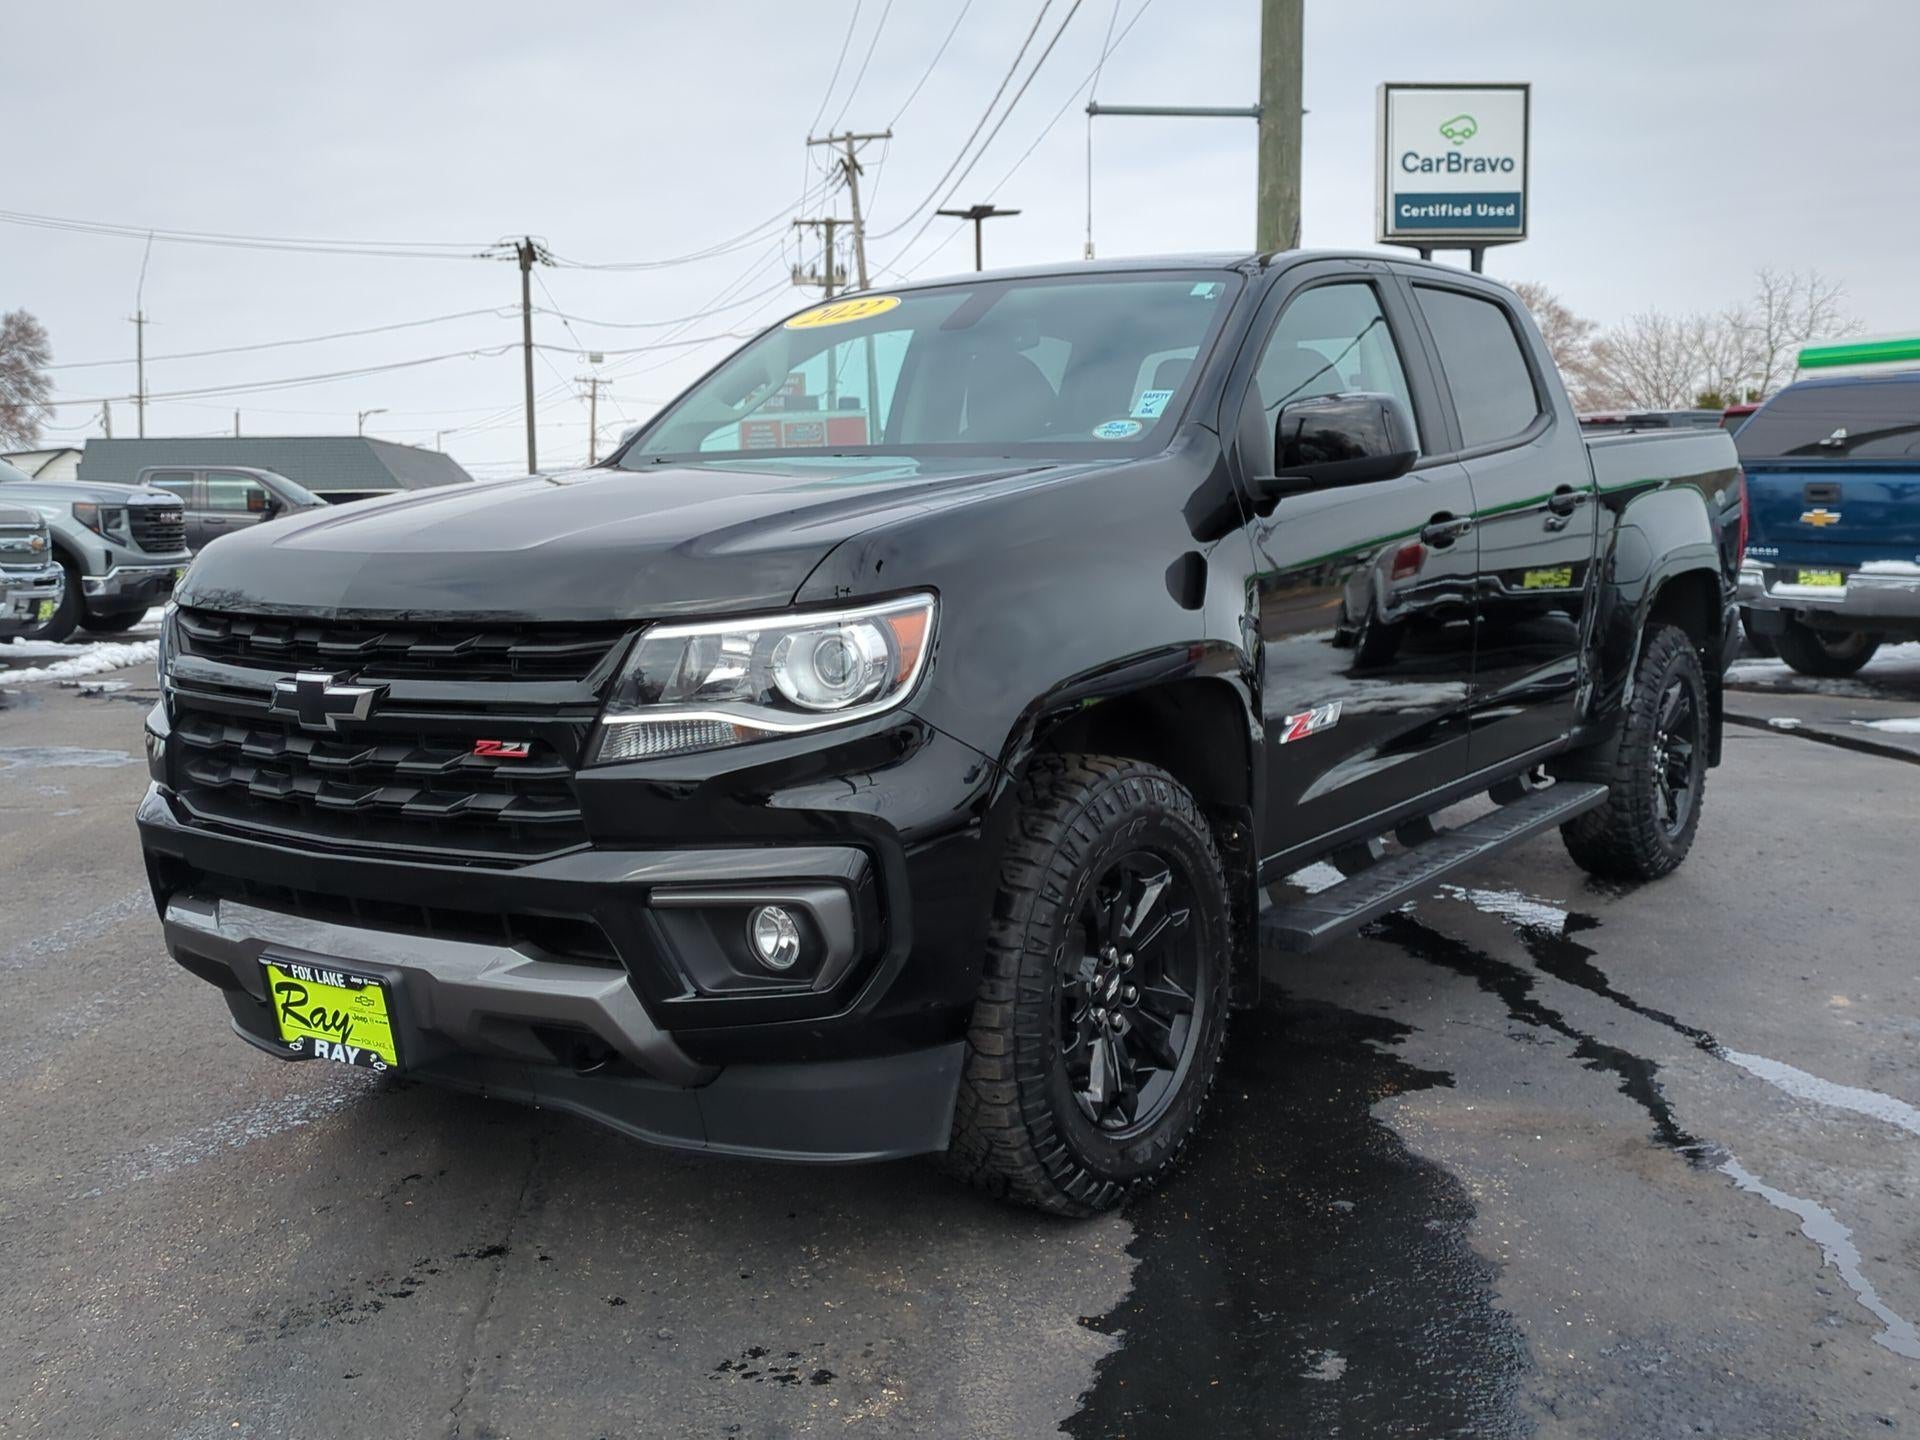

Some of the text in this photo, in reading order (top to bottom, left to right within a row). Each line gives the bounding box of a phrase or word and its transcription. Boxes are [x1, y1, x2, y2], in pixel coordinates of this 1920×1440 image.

[1401, 152, 1514, 173] CarBravo
[1401, 203, 1516, 217] Certified Used
[1279, 700, 1342, 744] Z71
[291, 964, 346, 988] FOX LAKE
[275, 981, 353, 1044] Ray
[314, 1039, 360, 1065] RAY
